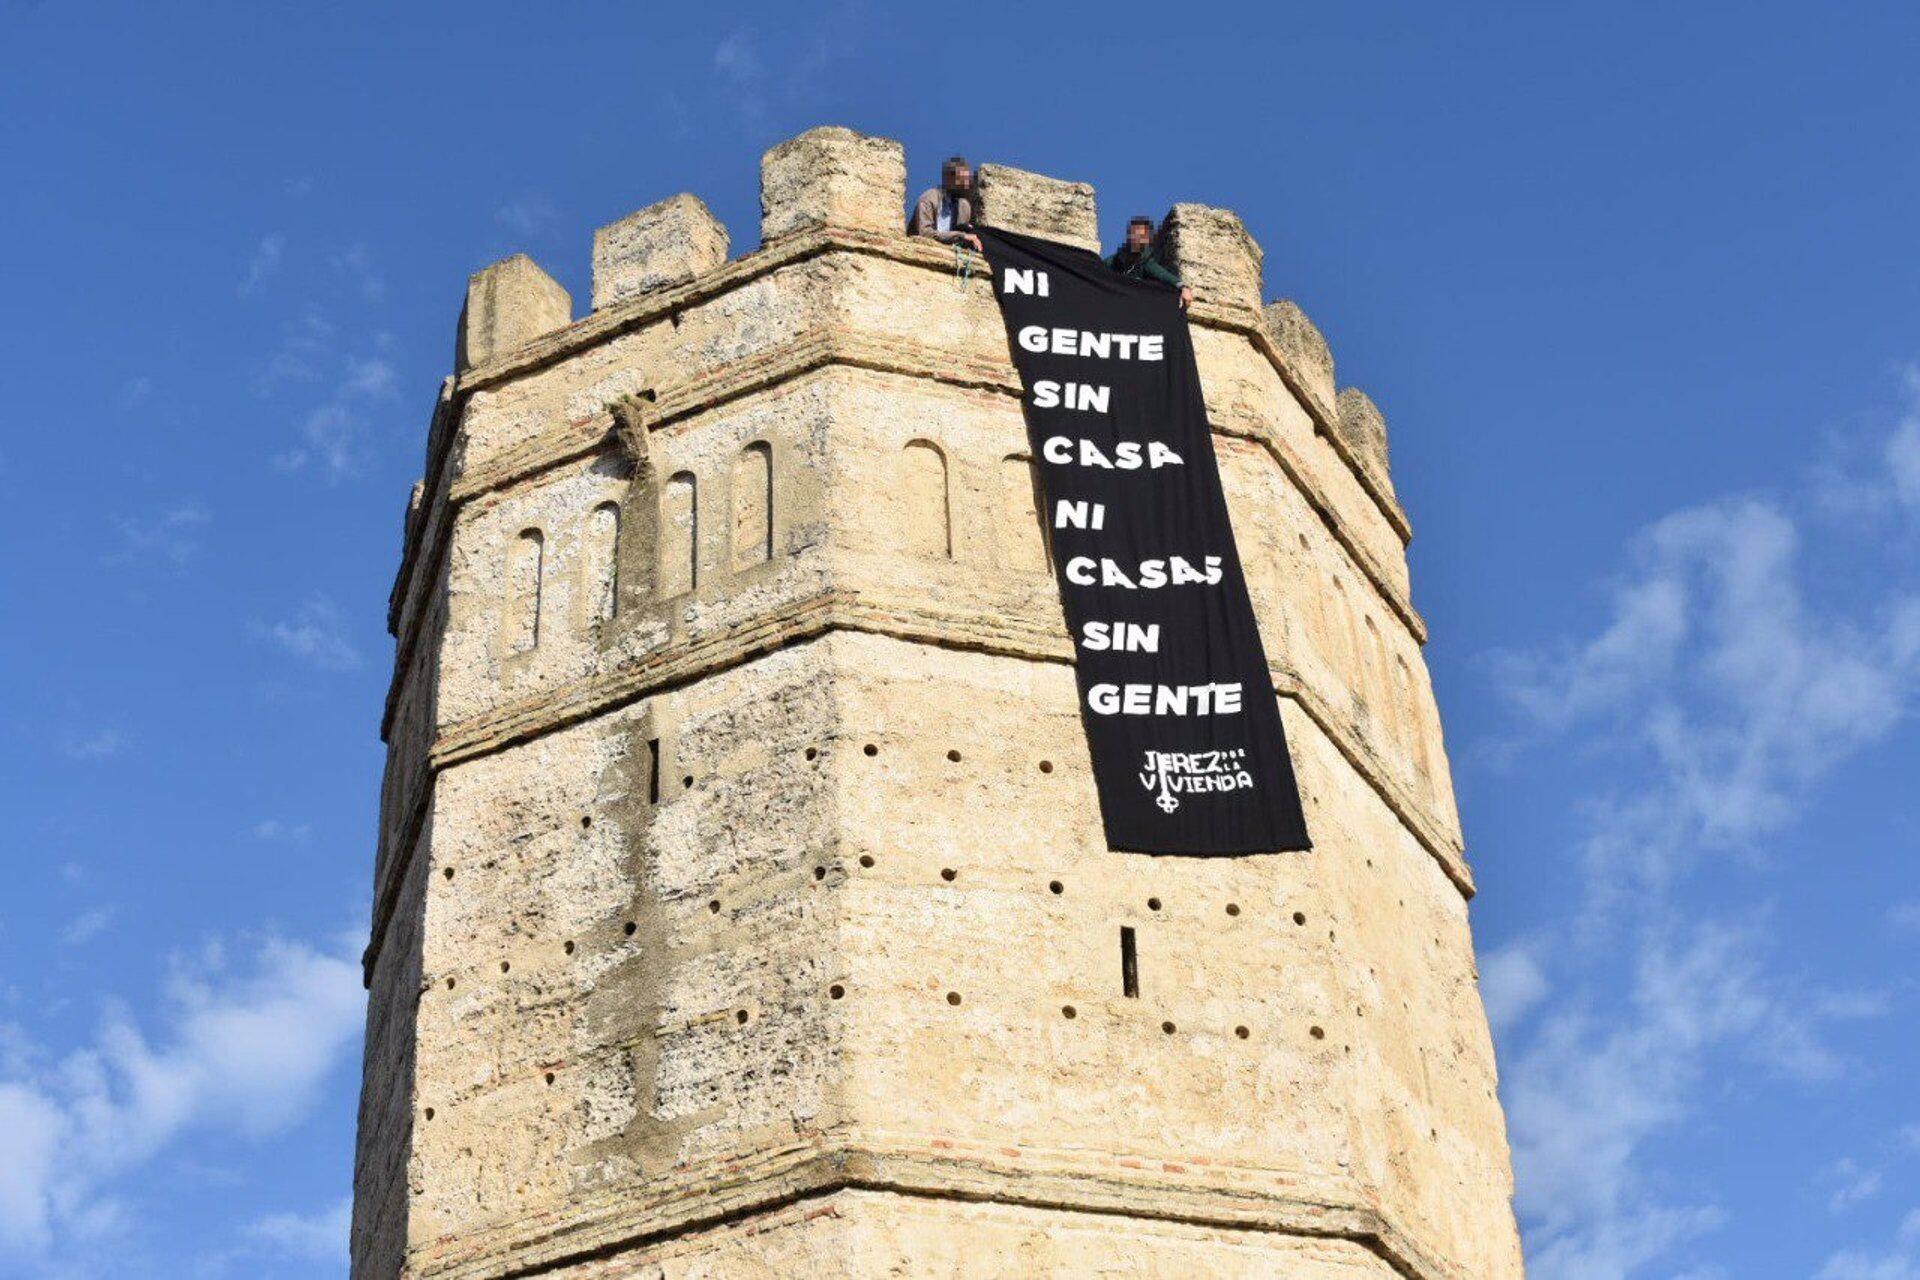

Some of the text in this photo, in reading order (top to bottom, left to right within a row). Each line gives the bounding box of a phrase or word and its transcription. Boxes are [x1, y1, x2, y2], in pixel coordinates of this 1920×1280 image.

[1003, 267, 1050, 298] NI
[1018, 324, 1165, 362] GENTE
[1032, 379, 1112, 414] SIN
[1042, 435, 1185, 471] CASA
[1054, 499, 1106, 531] NI
[1065, 555, 1223, 589] CASAS
[1081, 620, 1161, 654] SIN
[1088, 681, 1243, 717] GENTE
[1144, 750, 1223, 773] JEREZ
